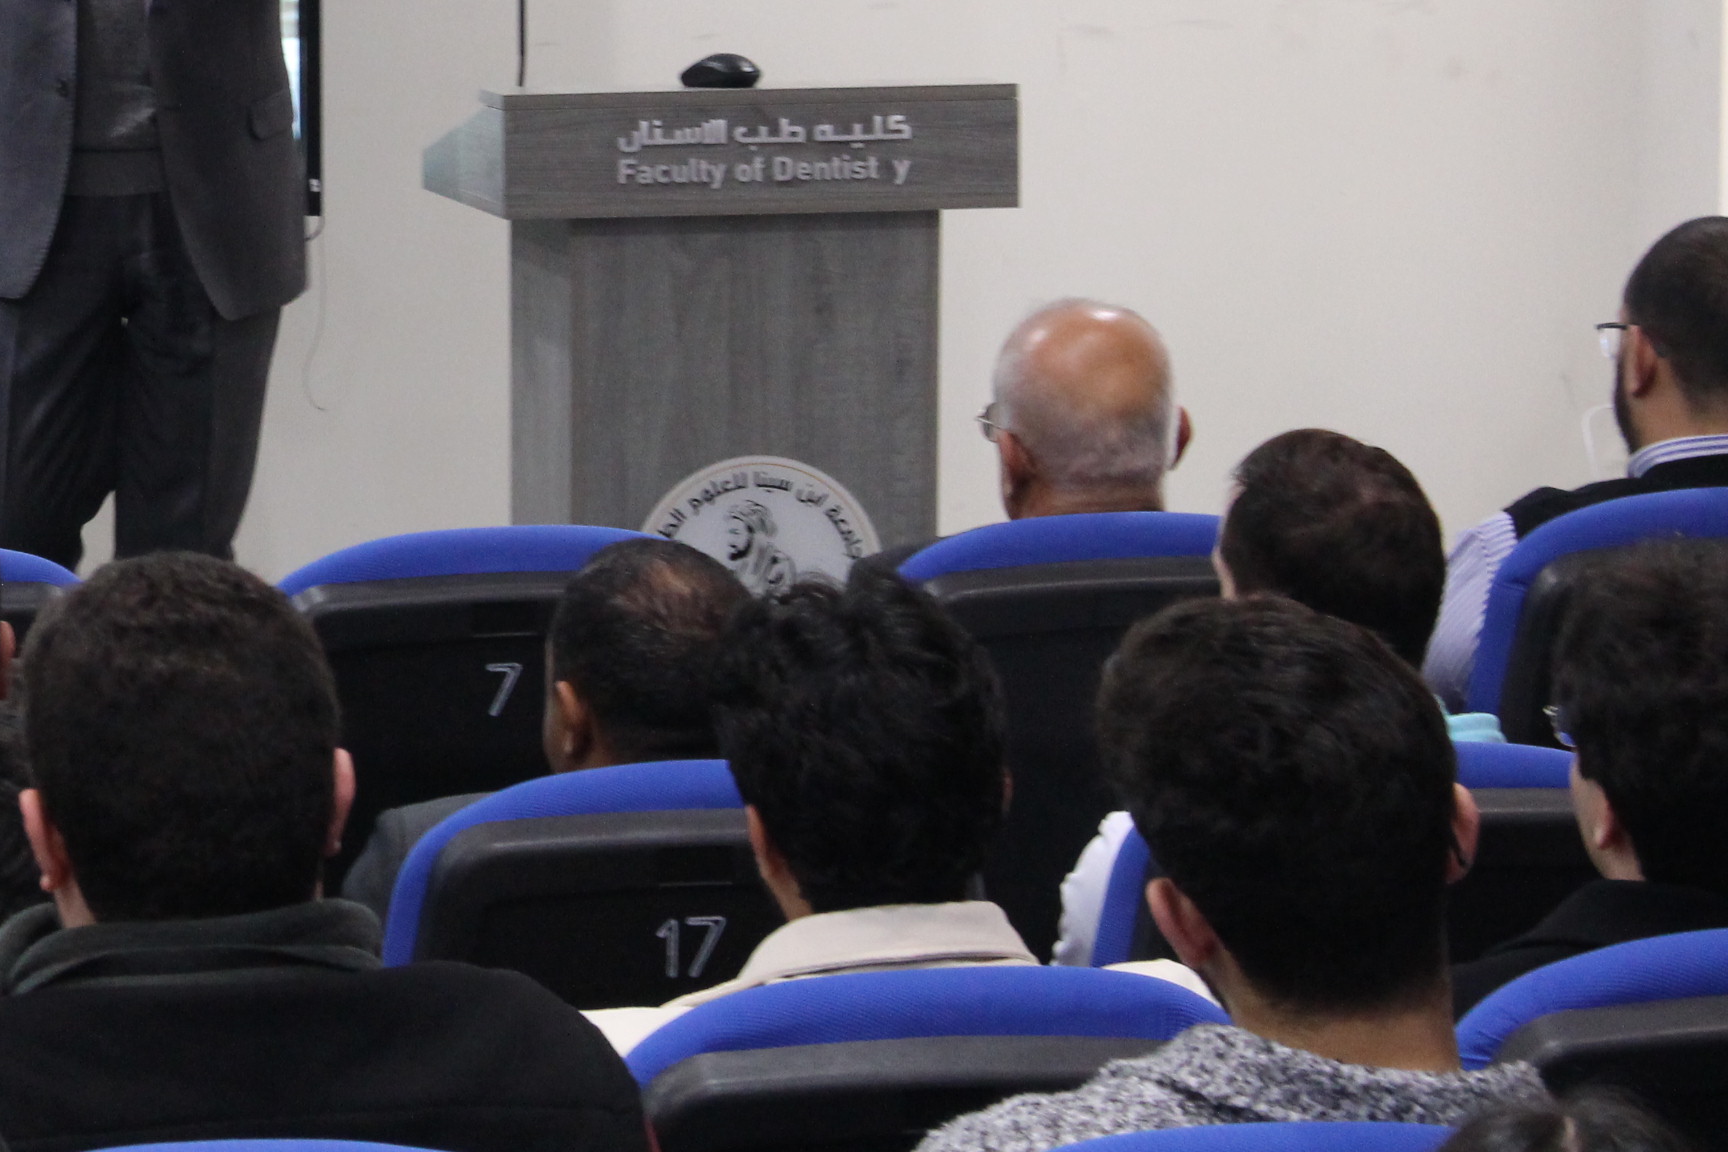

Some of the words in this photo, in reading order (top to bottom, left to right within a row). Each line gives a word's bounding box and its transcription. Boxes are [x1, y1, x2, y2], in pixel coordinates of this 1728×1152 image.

[733, 117, 806, 151] طب
[617, 157, 726, 189] Faculty
[734, 155, 765, 182] of
[484, 662, 524, 717] 7
[655, 915, 727, 978] 17
